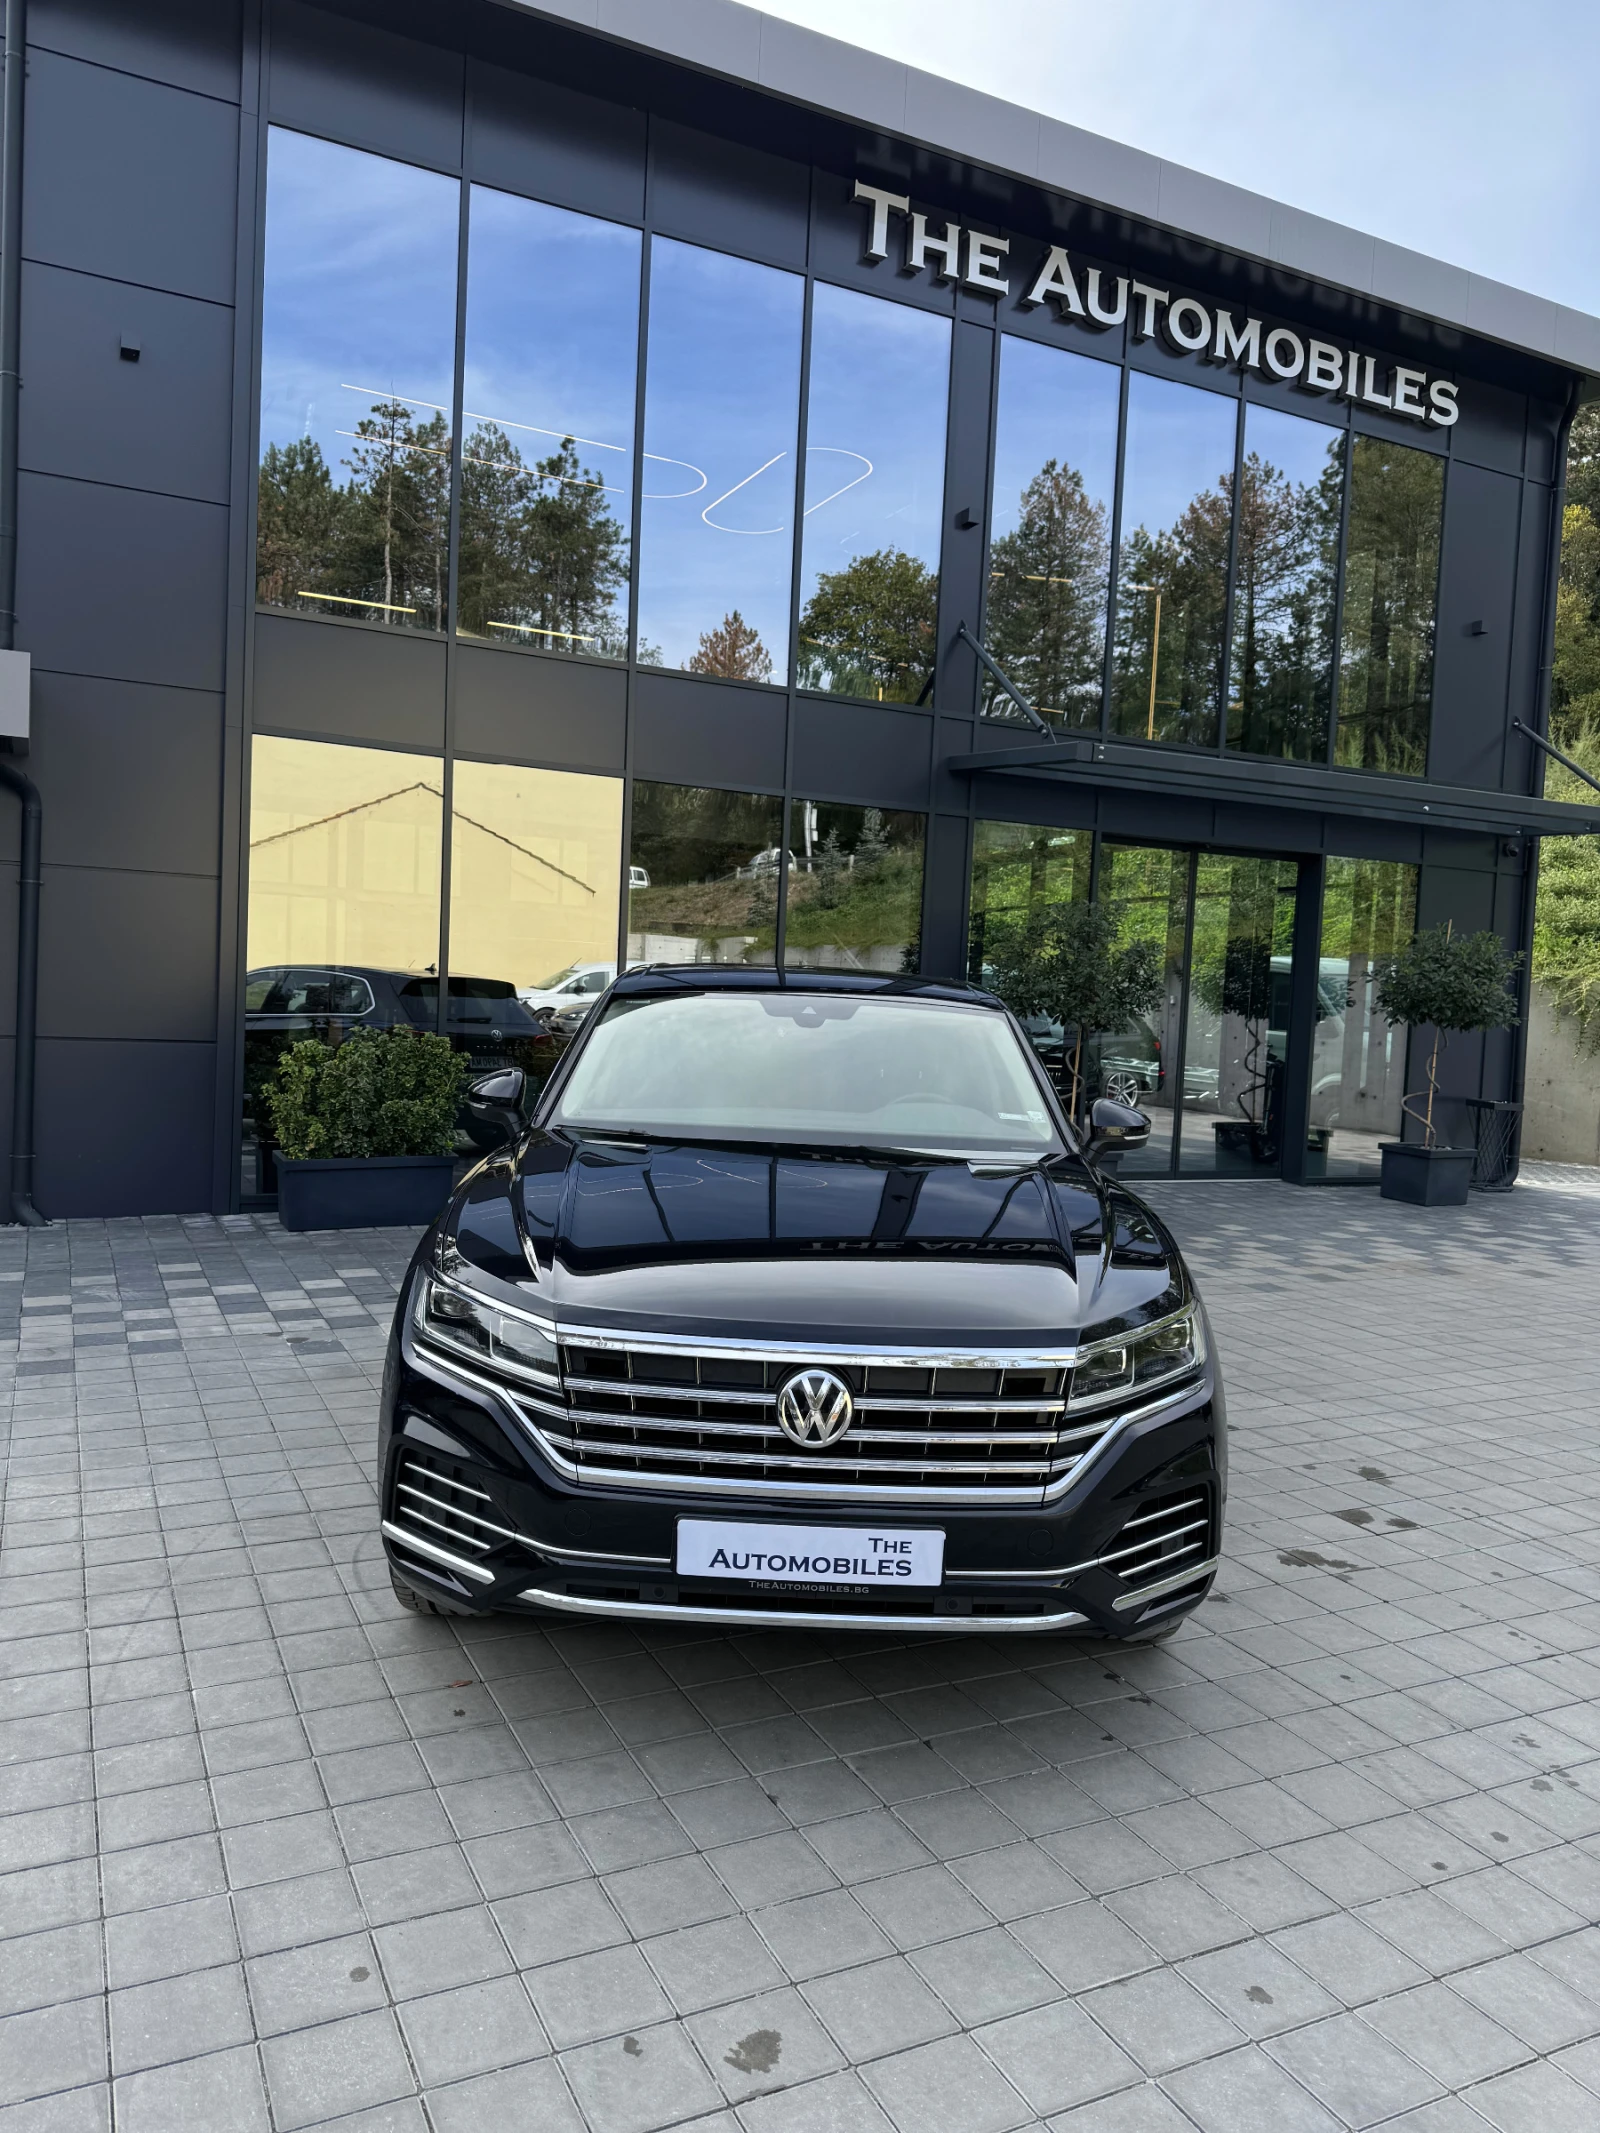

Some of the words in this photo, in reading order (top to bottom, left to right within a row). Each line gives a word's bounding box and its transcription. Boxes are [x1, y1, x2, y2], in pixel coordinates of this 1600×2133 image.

[853, 179, 1010, 296] THE
[1026, 244, 1460, 427] AUTOMOBILES
[868, 1537, 912, 1554] THE
[708, 1549, 912, 1577] AUTOMOBILES
